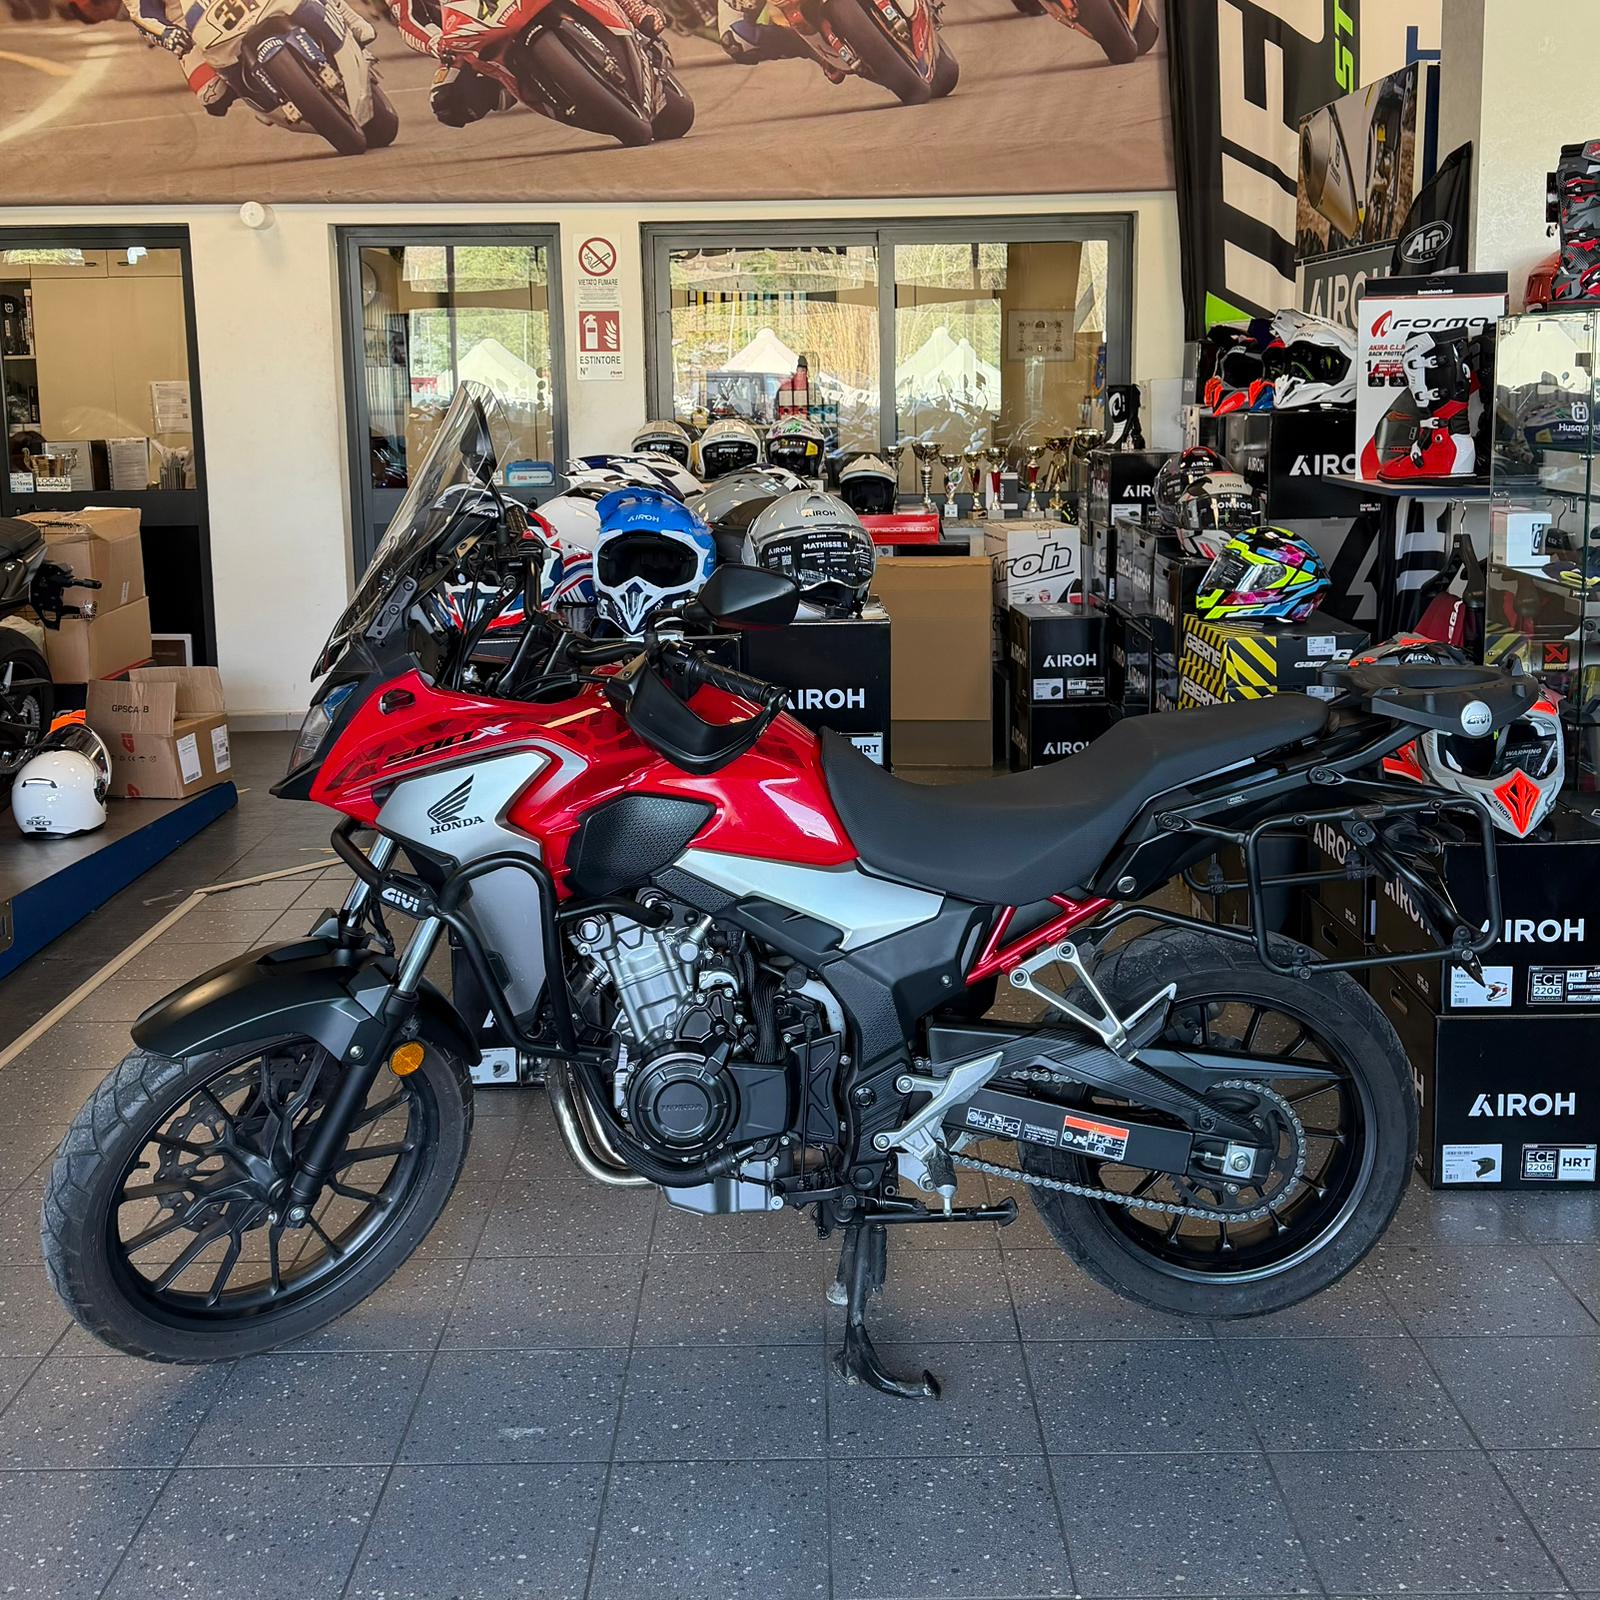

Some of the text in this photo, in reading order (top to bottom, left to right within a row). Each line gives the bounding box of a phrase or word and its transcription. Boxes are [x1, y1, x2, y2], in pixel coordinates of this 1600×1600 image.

[579, 355, 621, 365] ESTINTORE
[1122, 484, 1155, 498] AIR
[627, 513, 660, 523] AIROH
[767, 546, 792, 555] AIROH
[803, 541, 842, 550] MATHISSE
[1042, 653, 1097, 668] AIROH
[1505, 747, 1542, 757] WARNING
[430, 815, 486, 836] HONDA
[1533, 974, 1562, 986] ECE
[1534, 987, 1561, 995] 2206
[1468, 1092, 1576, 1117] AIROH
[1527, 1152, 1555, 1162] ECE
[1562, 1157, 1591, 1167] HRT
[1528, 1163, 1553, 1171] 2206
